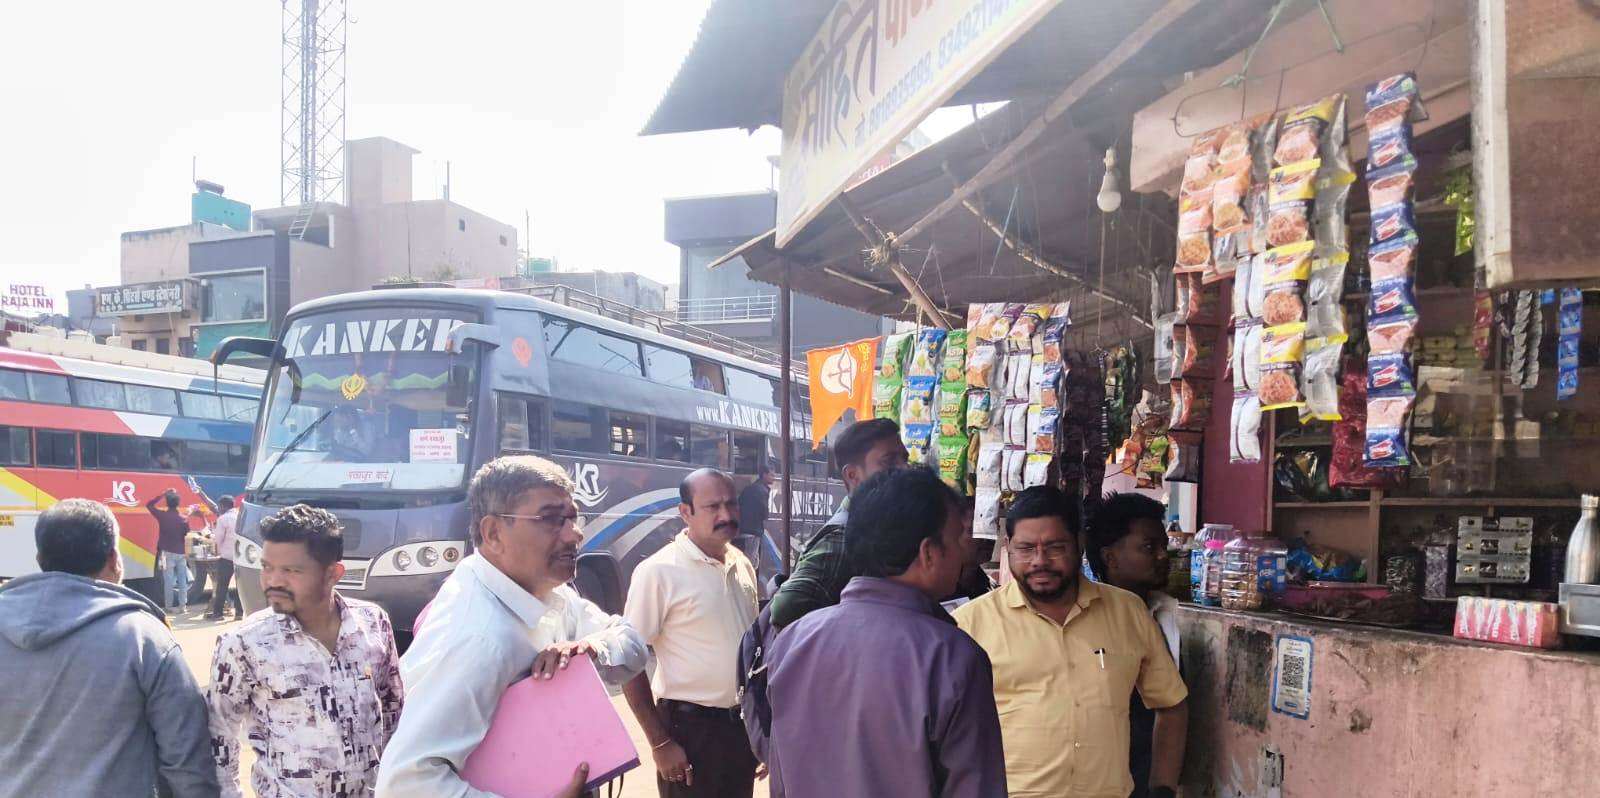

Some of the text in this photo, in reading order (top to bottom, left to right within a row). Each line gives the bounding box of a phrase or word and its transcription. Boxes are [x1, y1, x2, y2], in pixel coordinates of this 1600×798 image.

[9, 283, 48, 297] HOTEL
[32, 297, 54, 310] INN
[575, 462, 600, 496] KR
[111, 480, 138, 503] KR
[768, 488, 834, 516] KNKER
